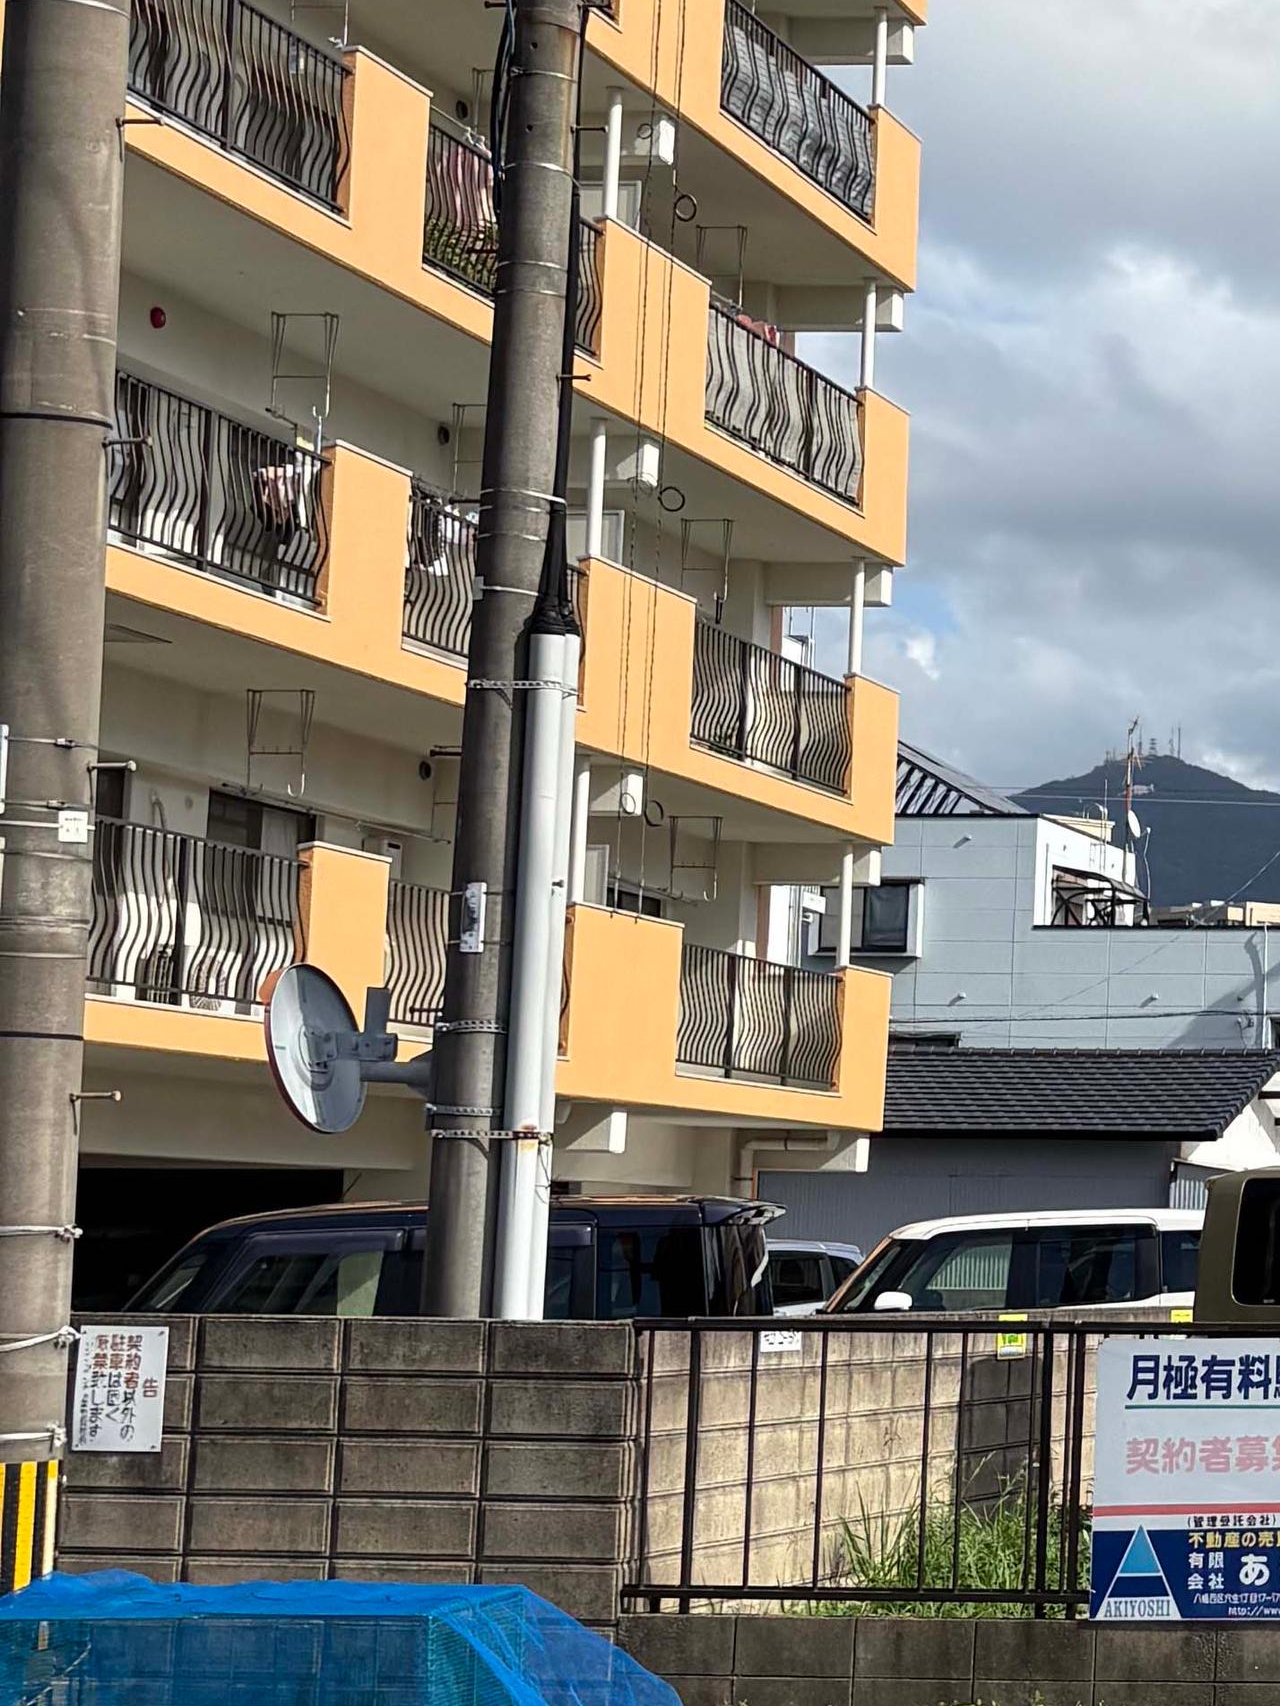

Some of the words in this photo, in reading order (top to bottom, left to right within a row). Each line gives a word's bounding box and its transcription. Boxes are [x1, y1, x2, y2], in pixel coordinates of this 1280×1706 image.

[119, 1334, 144, 1441] 契約者以外の
[1187, 1551, 1225, 1570] 有限
[1187, 1573, 1225, 1591] 会社
[1103, 1598, 1171, 1619] AKIYOSHI
